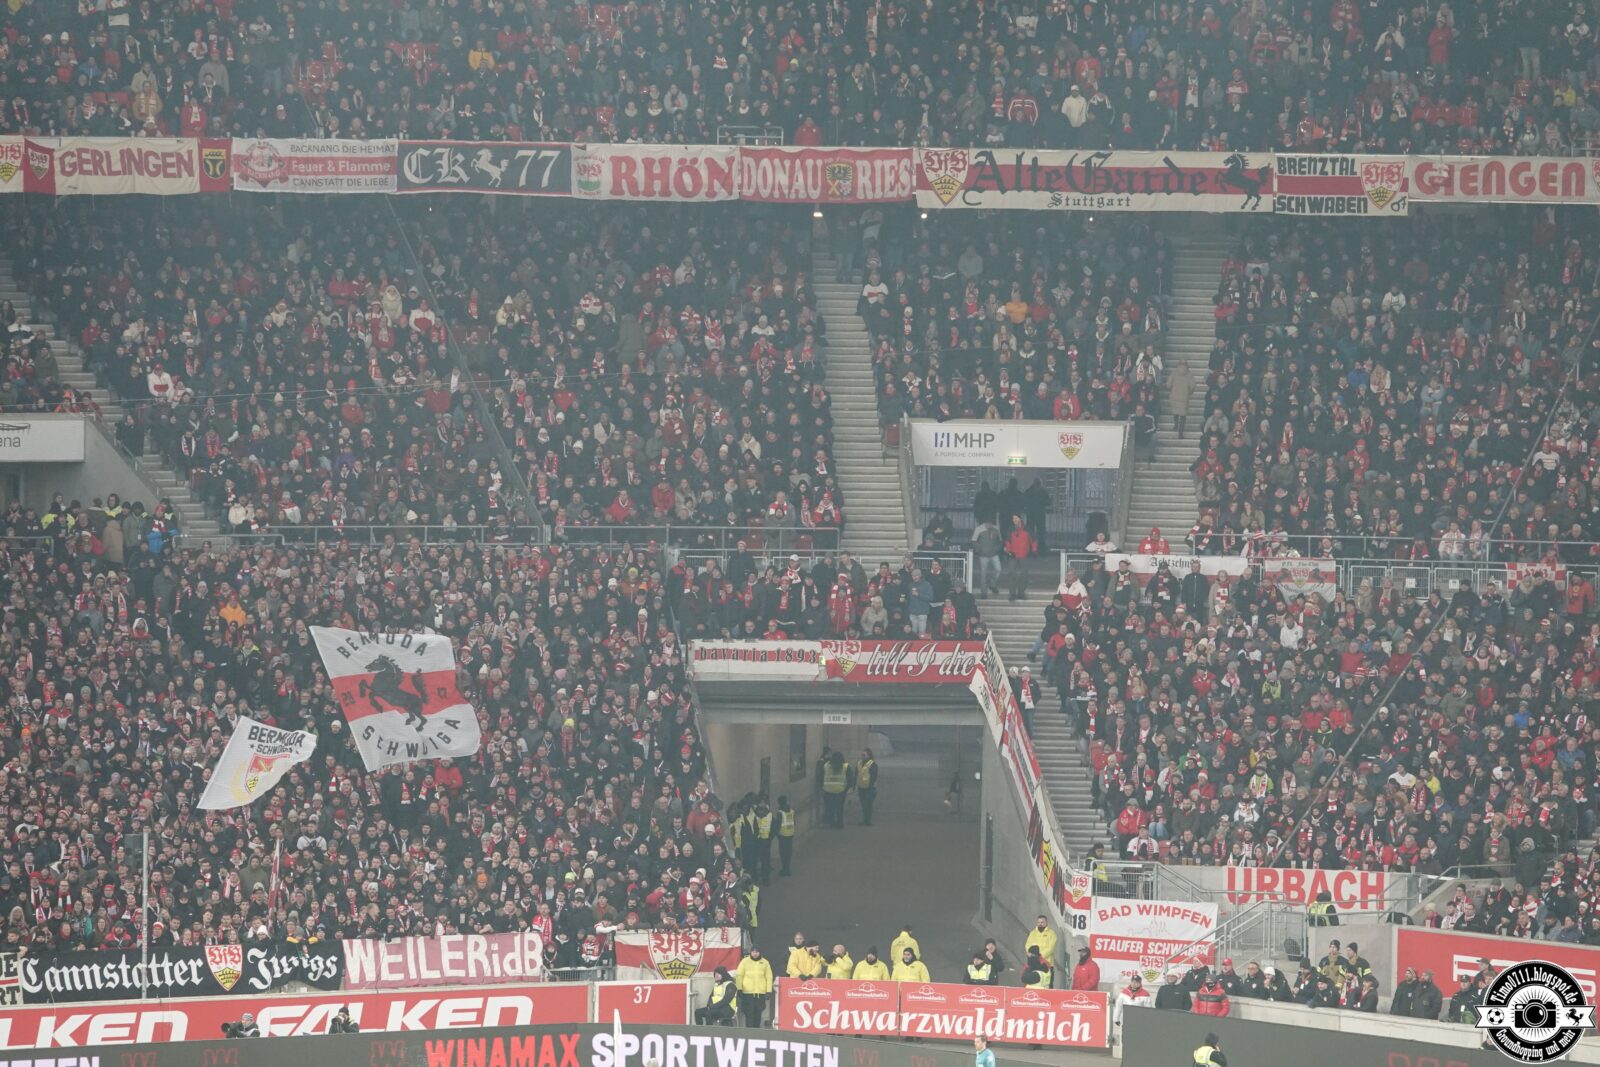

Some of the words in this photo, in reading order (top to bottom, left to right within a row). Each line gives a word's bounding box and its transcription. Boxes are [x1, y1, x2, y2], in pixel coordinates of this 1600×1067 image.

[291, 144, 340, 154] BACKNANG
[342, 144, 357, 154] DIE
[359, 144, 396, 154] HEIMAT
[59, 148, 195, 178] GERLINGEN
[291, 160, 325, 172] Feuer
[327, 160, 336, 172] &
[338, 159, 390, 172] Flamme
[514, 150, 561, 188] 77
[924, 150, 967, 174] VfB
[1276, 157, 1358, 176] BRENZTAL
[293, 177, 344, 187] CANNSTATT
[346, 177, 361, 187] DIE
[364, 177, 389, 187] LIEBE
[609, 155, 735, 198] RHÖN
[742, 158, 823, 199] DONAU
[856, 158, 911, 199] RIES
[962, 150, 1061, 206] Alte
[1066, 151, 1208, 196] Garde
[1364, 164, 1403, 186] VfB
[1414, 160, 1585, 197] GIENGEN
[1047, 192, 1132, 209] Stuttgart
[1276, 195, 1368, 214] SCHWABEN
[953, 432, 995, 448] MHP
[1060, 435, 1083, 446] VfB
[700, 646, 767, 662] bavaria
[775, 648, 816, 664] 1893
[866, 642, 912, 676] till
[938, 642, 976, 677] die
[1227, 867, 1385, 911] URBACH
[1098, 905, 1132, 922] BAD
[1137, 904, 1213, 929] WIMPFEN
[208, 947, 242, 967] VfB
[1095, 937, 1144, 954] STAUFER
[21, 952, 204, 994] Cannstatter
[633, 985, 652, 1004] 37
[256, 996, 534, 1038] FALKEN
[793, 999, 1092, 1042] Schwarzwaldmilch
[425, 1033, 581, 1067] WINAMAX
[591, 1033, 839, 1067] SPORTWETTEN
